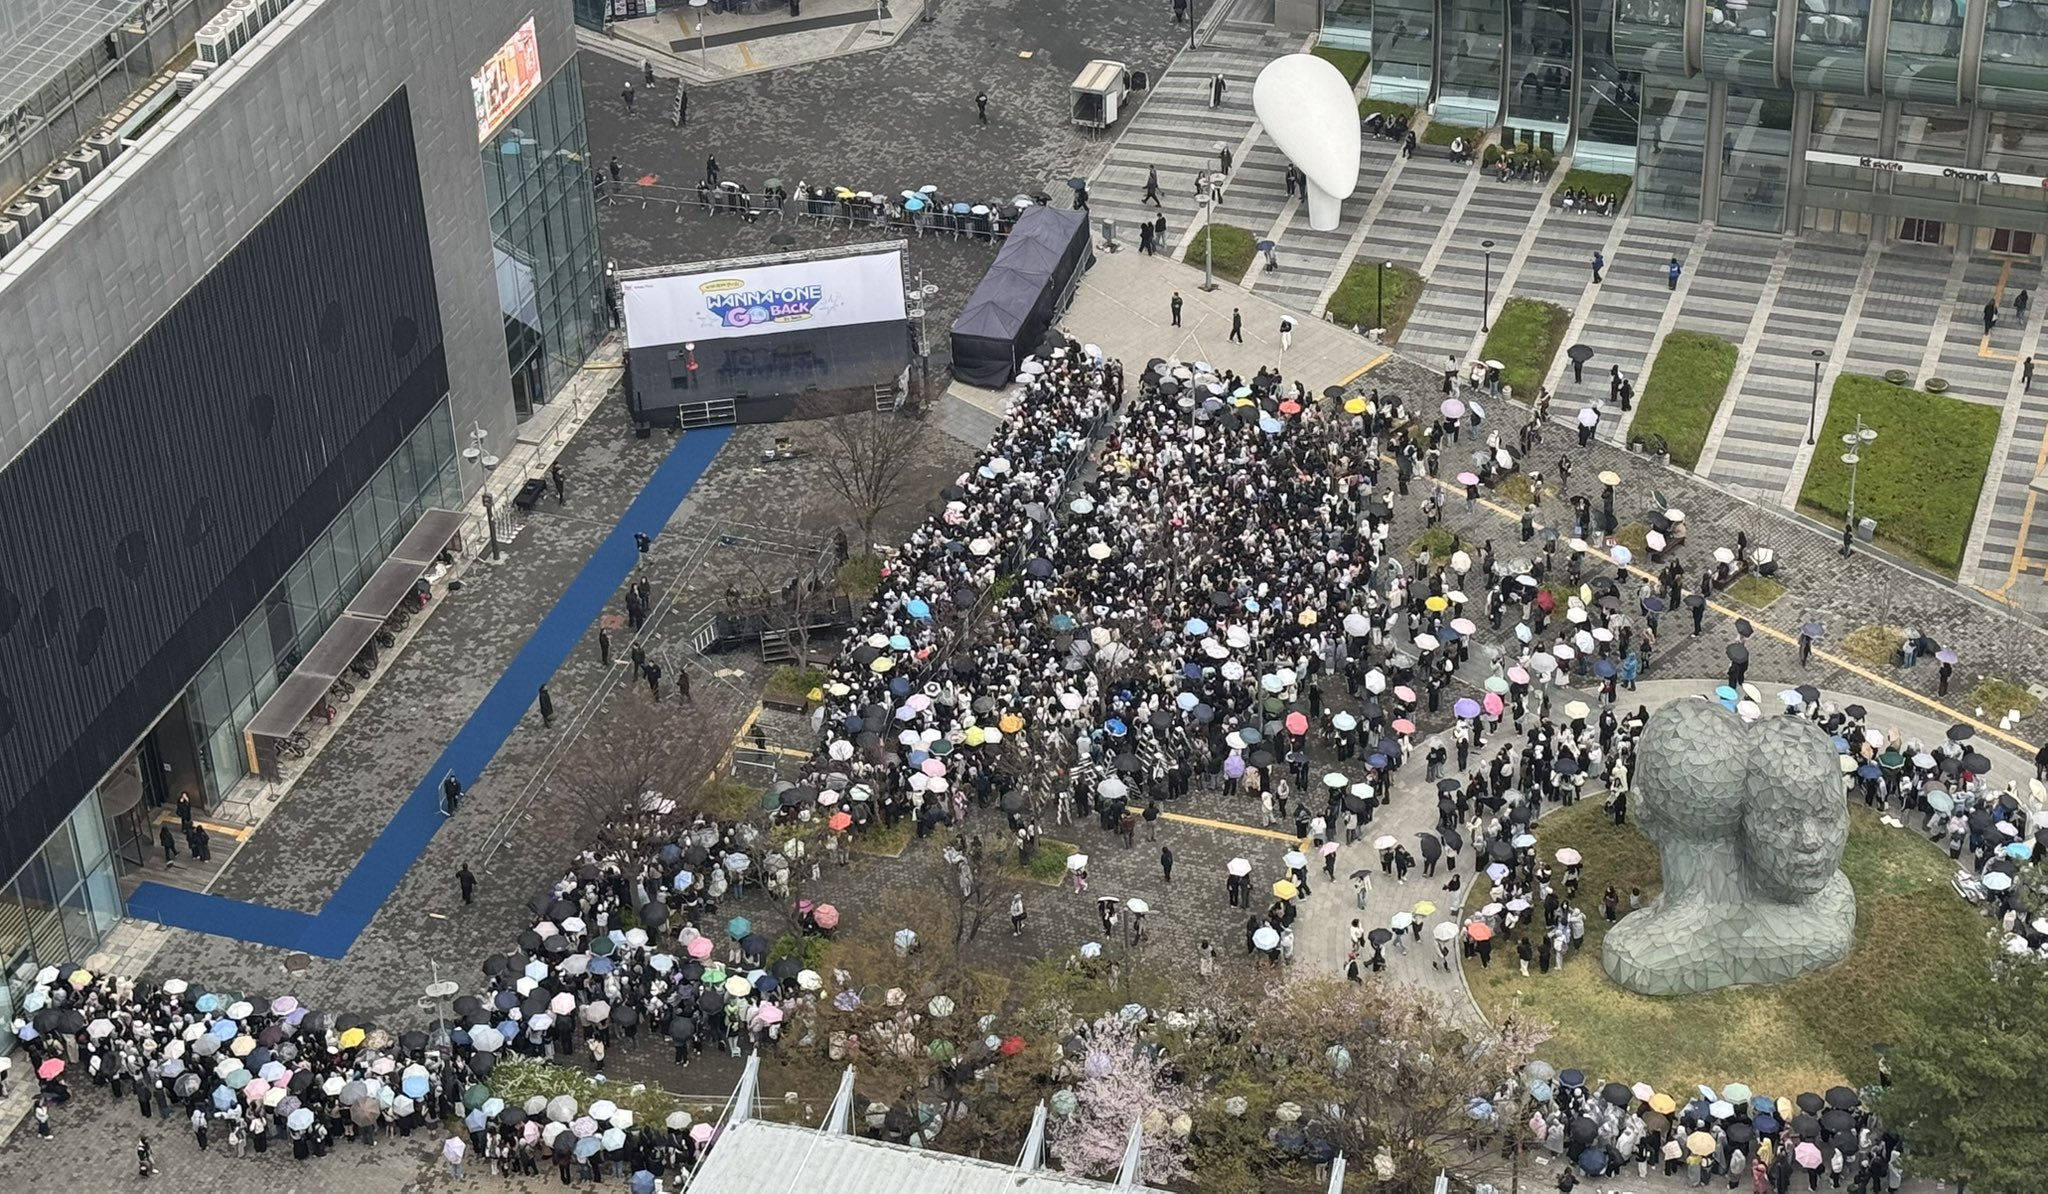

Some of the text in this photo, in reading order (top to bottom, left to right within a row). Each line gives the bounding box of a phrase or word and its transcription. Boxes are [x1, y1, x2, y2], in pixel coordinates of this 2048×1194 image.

[1860, 157, 1872, 167] kt
[1943, 168, 1988, 182] Channel
[728, 303, 809, 326] GO BACK
